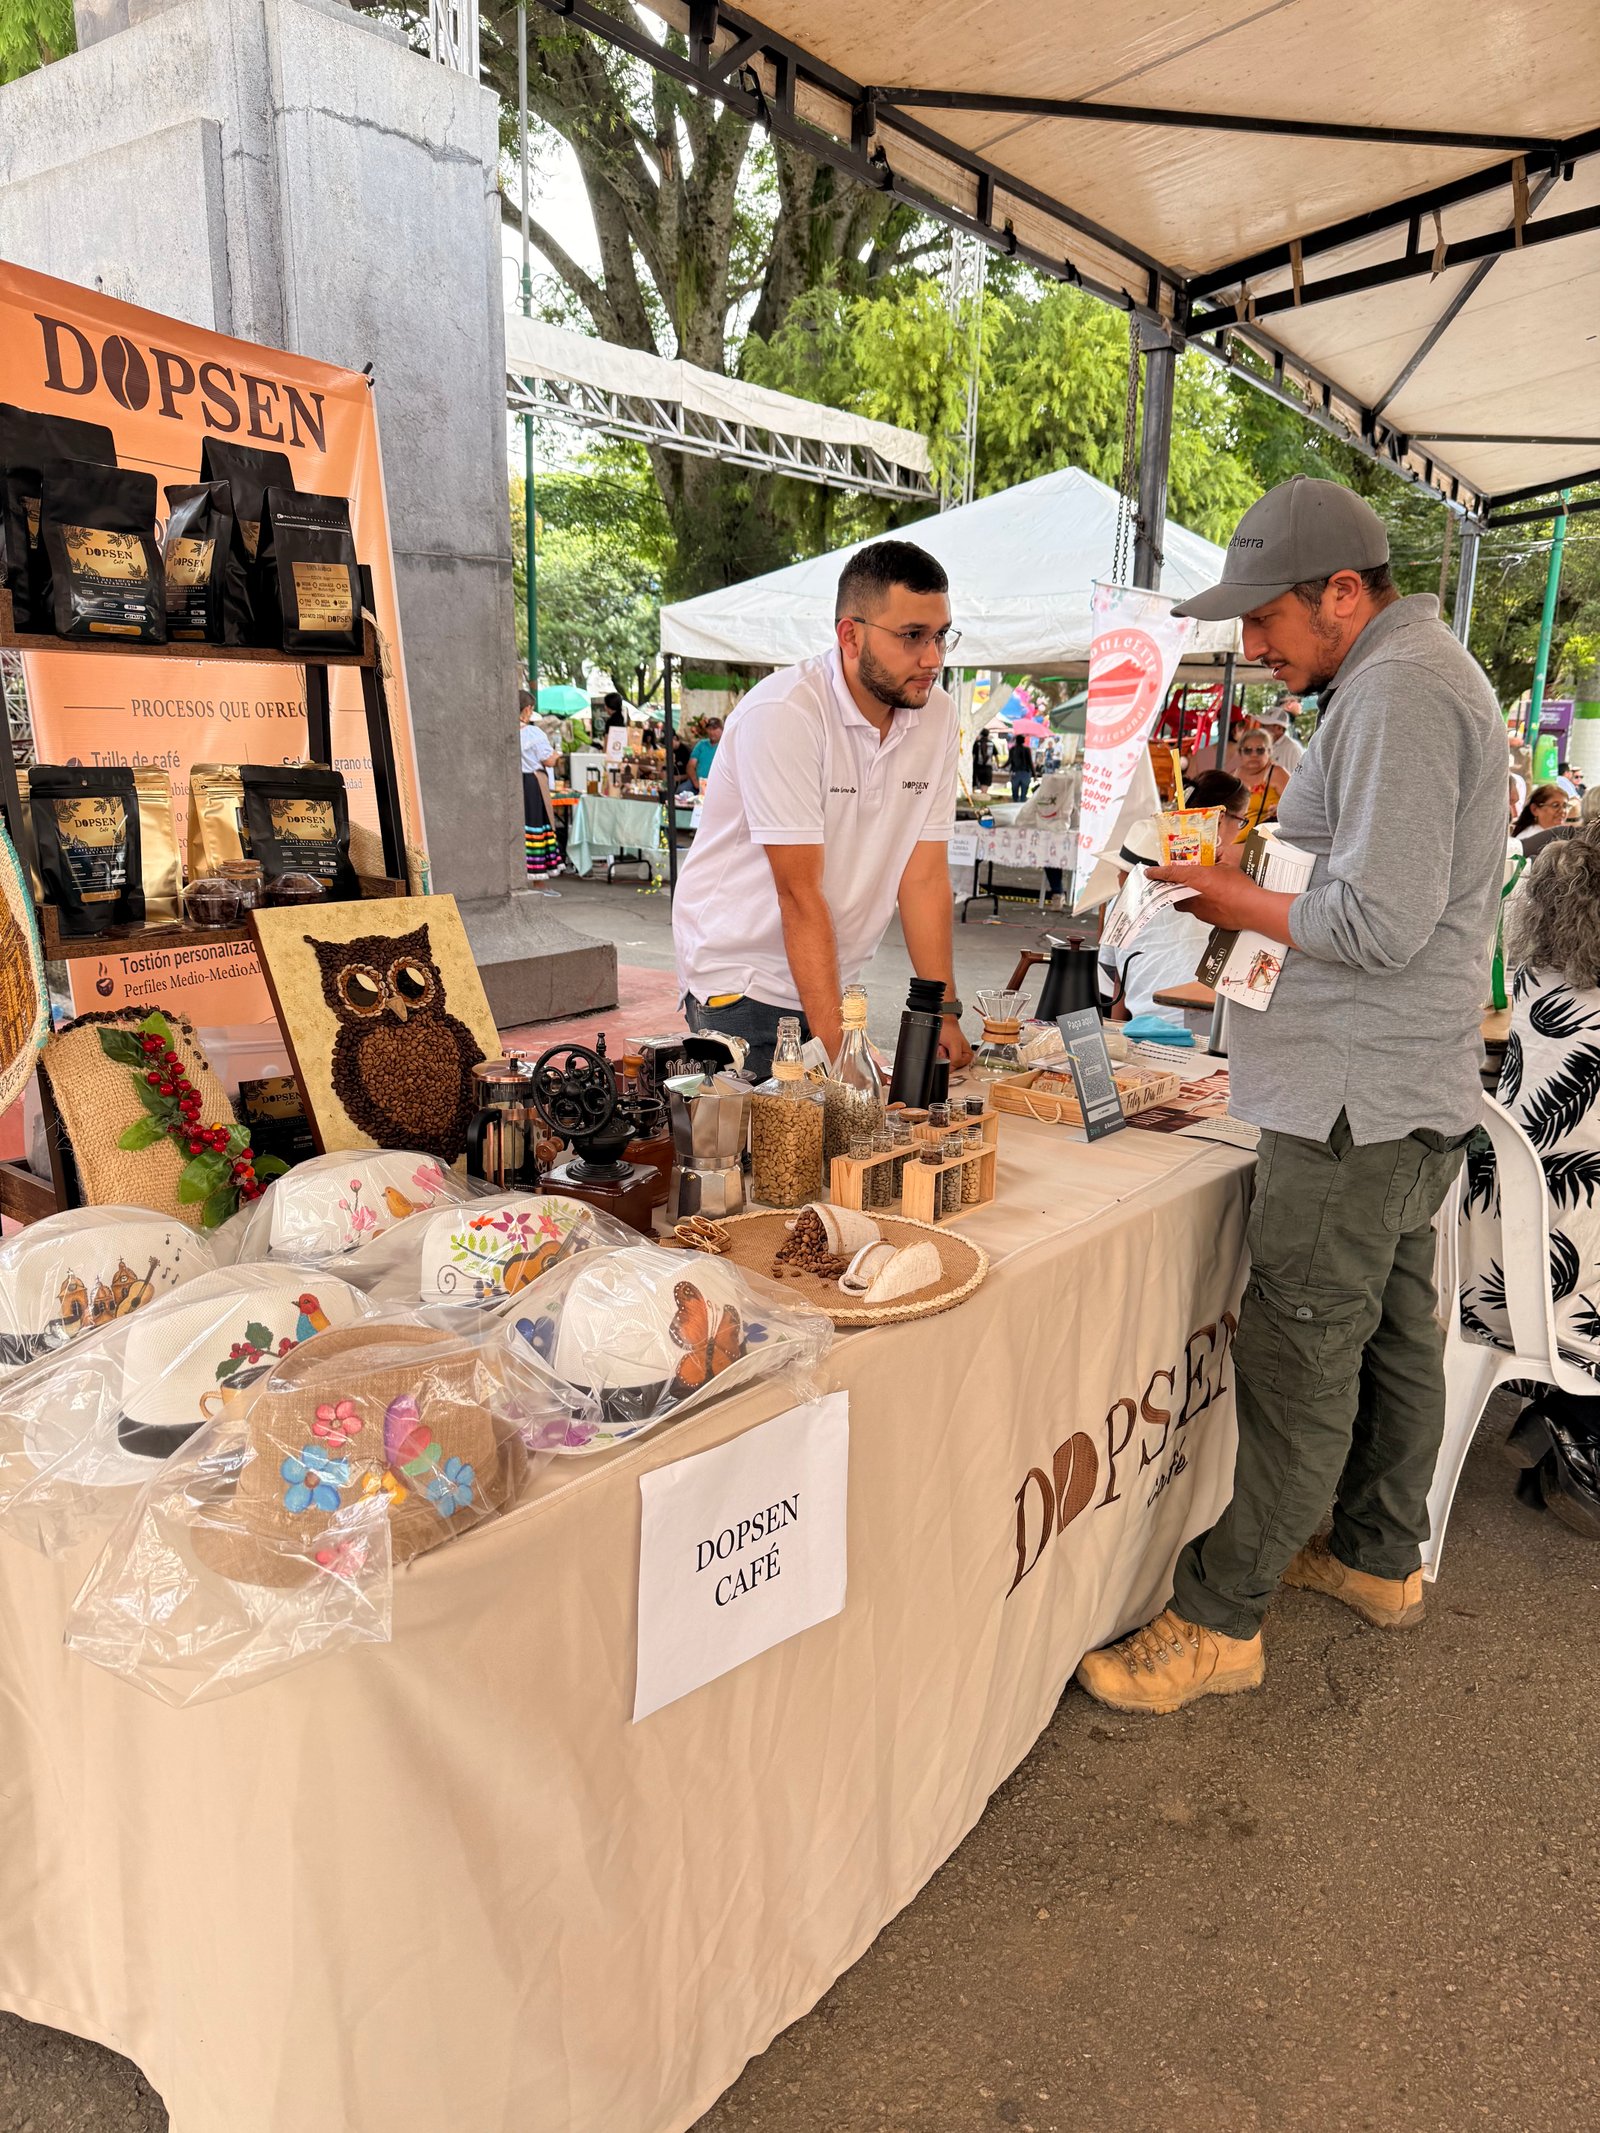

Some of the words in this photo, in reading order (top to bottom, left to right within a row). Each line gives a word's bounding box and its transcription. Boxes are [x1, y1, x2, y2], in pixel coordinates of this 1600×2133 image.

[85, 547, 133, 560] DOPSEN
[131, 699, 215, 718] PROCESOS
[219, 700, 250, 722] QUE
[255, 701, 307, 718] OFREC
[91, 751, 128, 767] Trilla
[132, 751, 149, 767] de
[153, 750, 180, 768] café
[334, 758, 361, 771] grano
[1101, 767, 1112, 778] tu
[902, 780, 929, 790] DOPSEN
[1099, 781, 1112, 791] en
[1083, 787, 1112, 804] sabor
[74, 817, 117, 828] DOPSEN
[287, 815, 326, 824] DOPSEN
[119, 951, 171, 975] Tostión
[123, 978, 168, 998] Perfiles
[170, 960, 262, 989] Medio-MedioAl
[665, 1058, 702, 1078] Music
[695, 1493, 800, 1573] DOPSEN
[714, 1542, 781, 1607] CAFÉ
